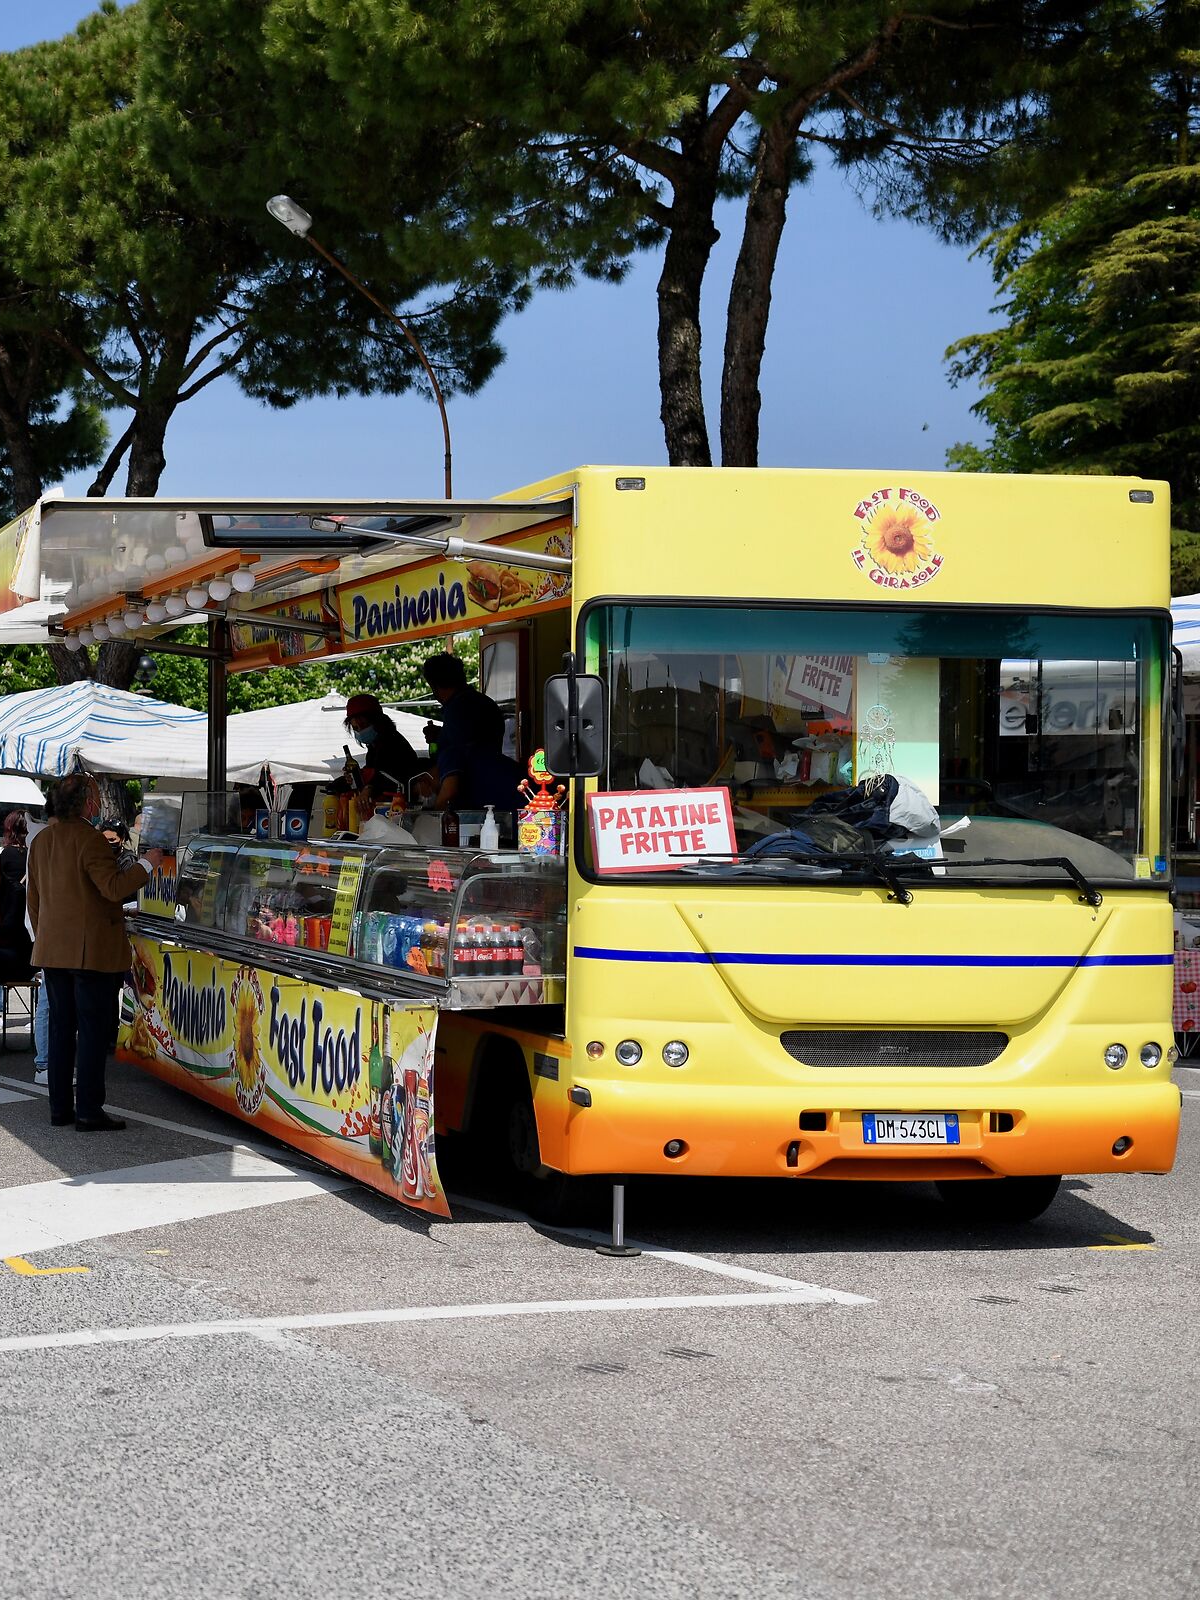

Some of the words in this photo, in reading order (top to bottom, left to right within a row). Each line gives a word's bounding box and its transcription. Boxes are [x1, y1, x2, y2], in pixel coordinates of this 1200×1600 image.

[854, 488, 892, 519] FAST
[899, 488, 940, 521] FOOD
[851, 549, 865, 570] IL
[869, 554, 944, 588] GIRASOLE
[353, 572, 466, 640] Panineria
[801, 664, 842, 697] FRITTE
[598, 803, 721, 831] PATATINE
[620, 829, 706, 855] FRITTE
[163, 952, 226, 1047] Panineria
[269, 987, 306, 1088] Fast
[311, 1000, 361, 1094] Food
